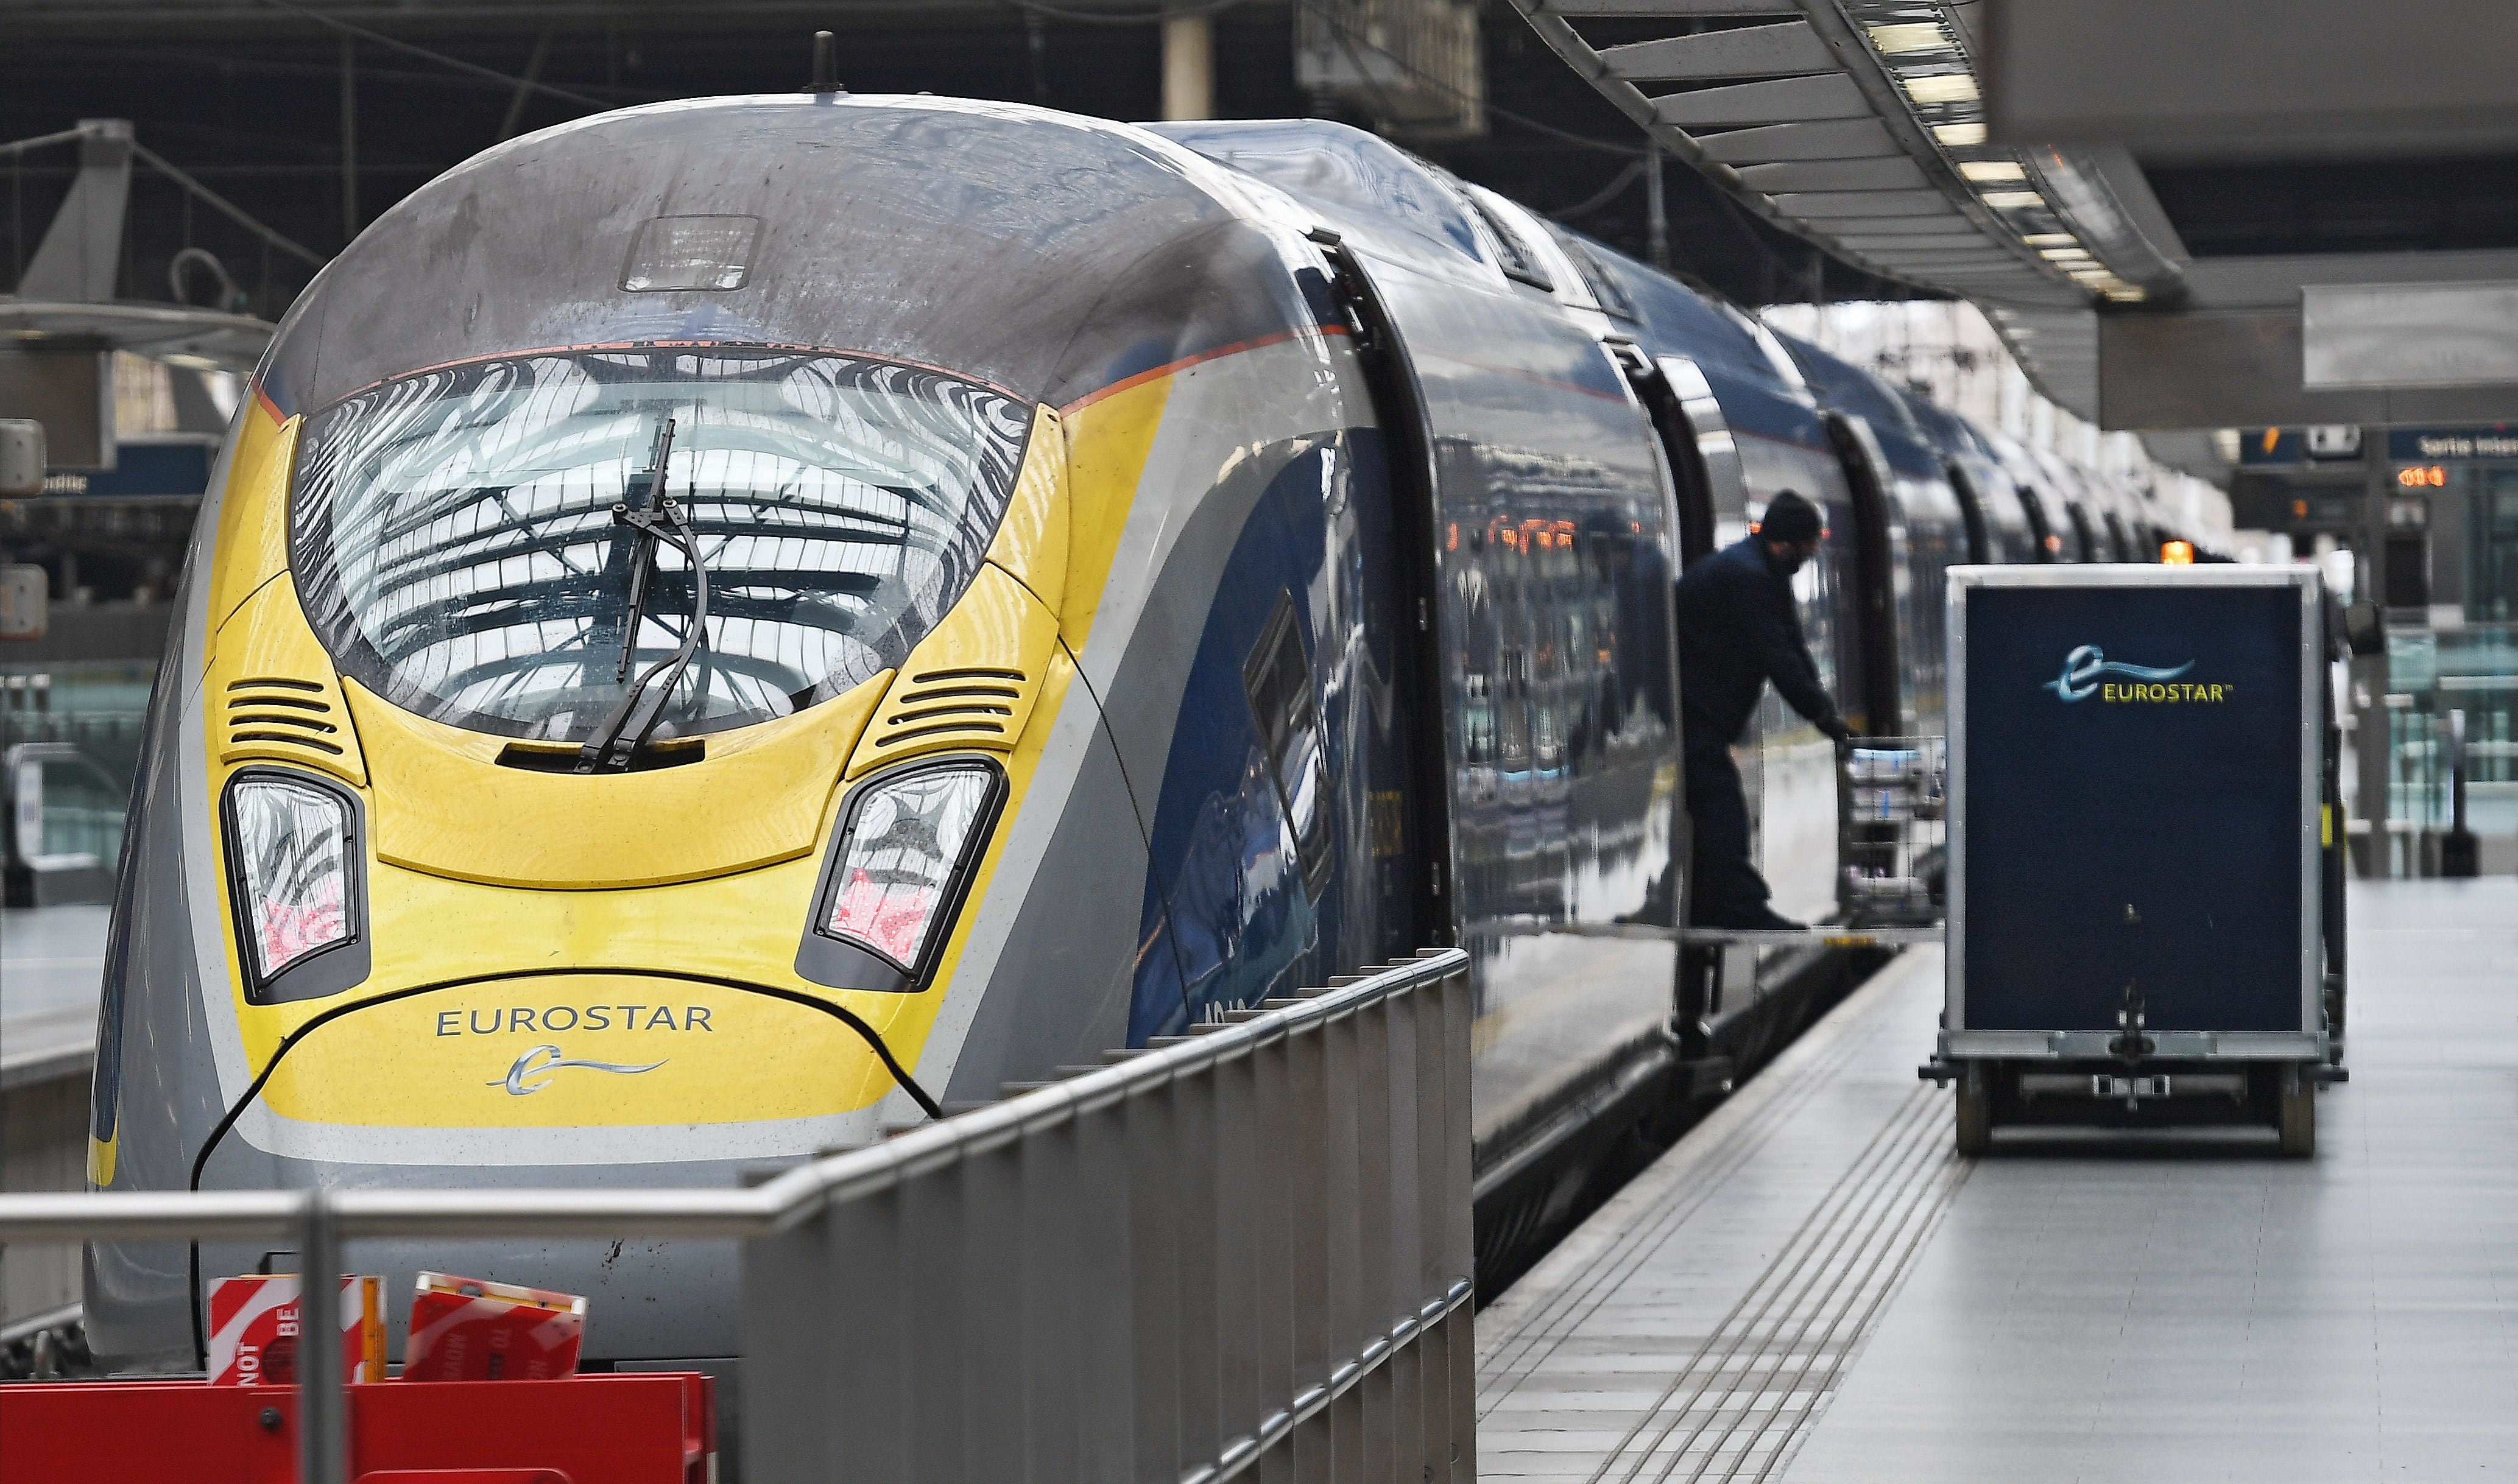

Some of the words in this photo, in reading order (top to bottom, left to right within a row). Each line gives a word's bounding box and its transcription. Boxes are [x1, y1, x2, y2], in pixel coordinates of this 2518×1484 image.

[436, 1005, 713, 1036] EUROSTAR
[276, 1308, 300, 1337] BE
[236, 1341, 260, 1388] NOT
